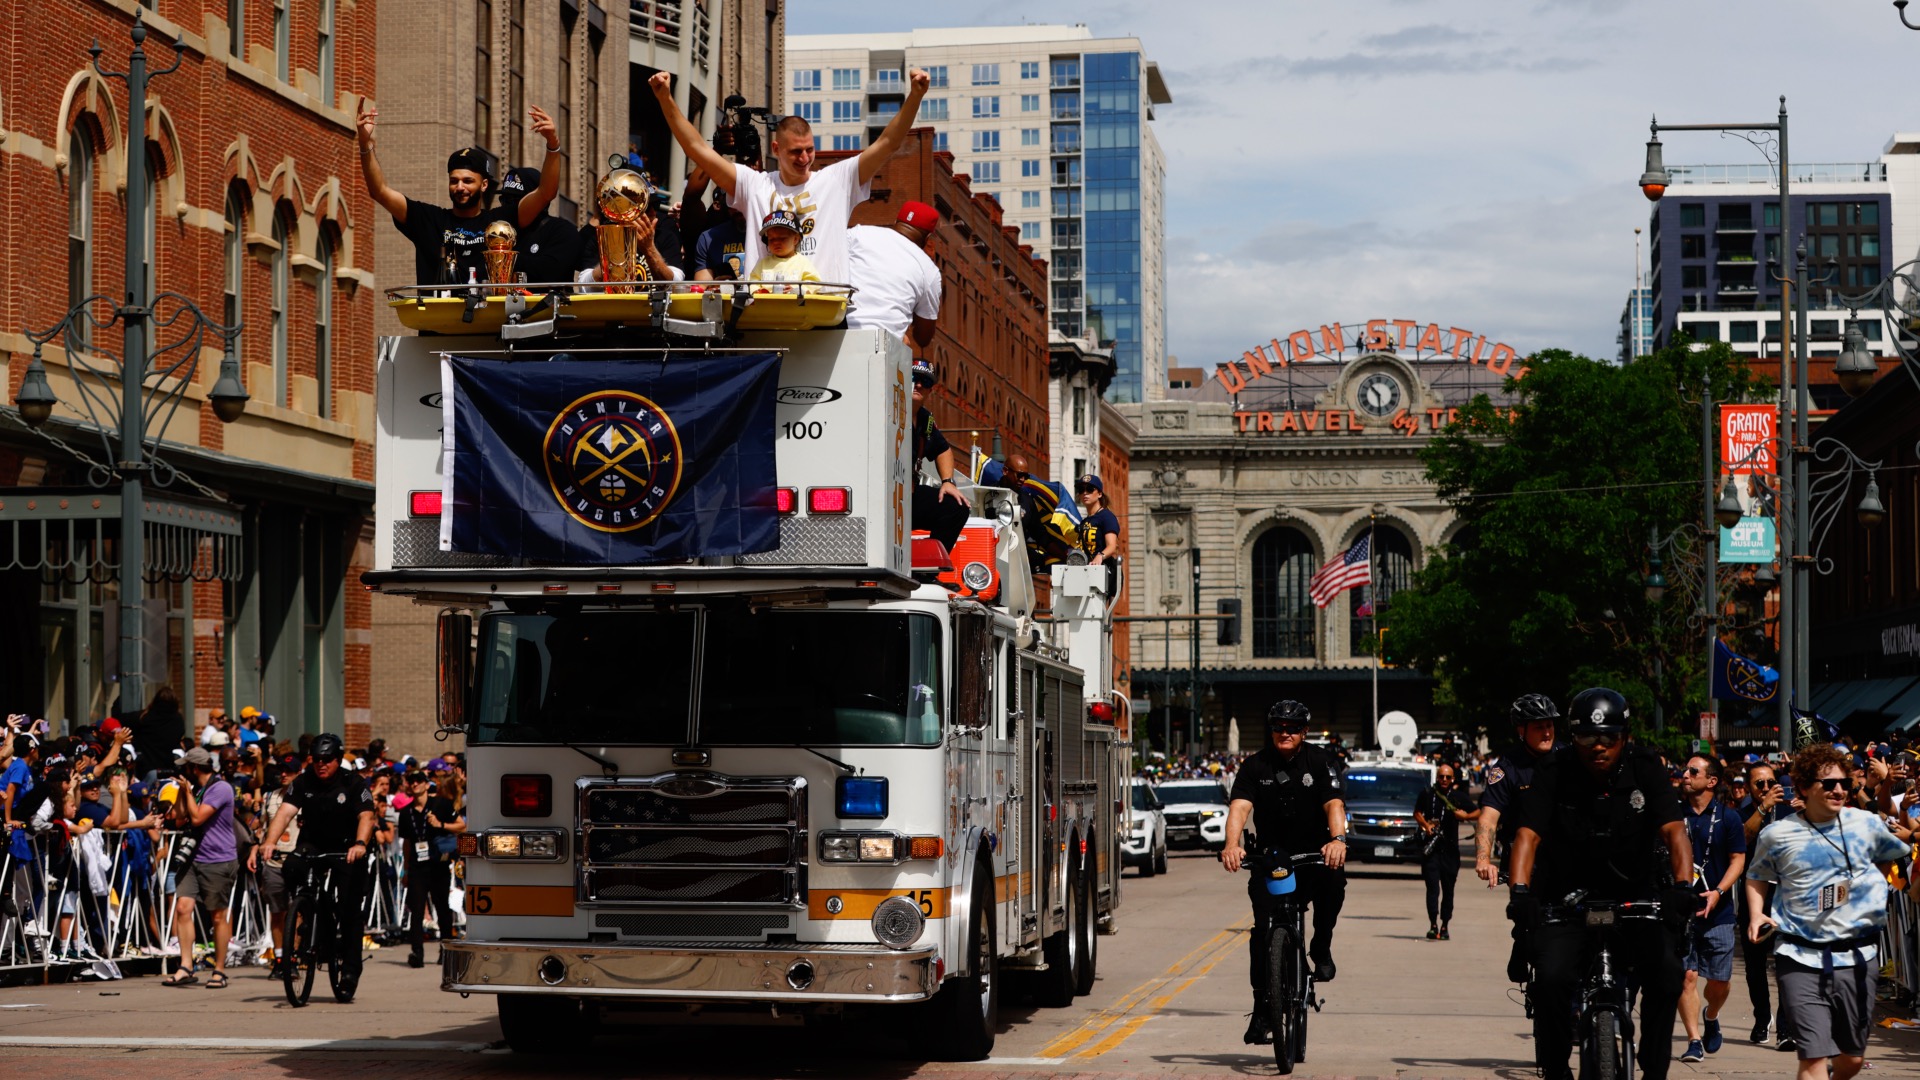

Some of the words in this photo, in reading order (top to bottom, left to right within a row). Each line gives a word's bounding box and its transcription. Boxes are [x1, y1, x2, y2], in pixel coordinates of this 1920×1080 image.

[723, 243, 744, 254] NBA
[1215, 321, 1345, 395] UNION
[1366, 318, 1533, 381] STATIO
[779, 389, 823, 401] Pierce
[561, 401, 663, 436] DENVER
[1234, 409, 1365, 433] TRAVEL
[1391, 408, 1420, 438] by
[1426, 407, 1519, 430] TRI
[1727, 412, 1771, 437] GRATIS
[1728, 437, 1770, 462] NIÑOS
[1740, 432, 1757, 442] PARA
[1289, 471, 1360, 487] UNION
[1381, 471, 1436, 486] STAT
[563, 484, 665, 523] NUGGETS
[1730, 522, 1765, 541] art
[1752, 739, 1763, 747] bar
[469, 886, 493, 914] 15
